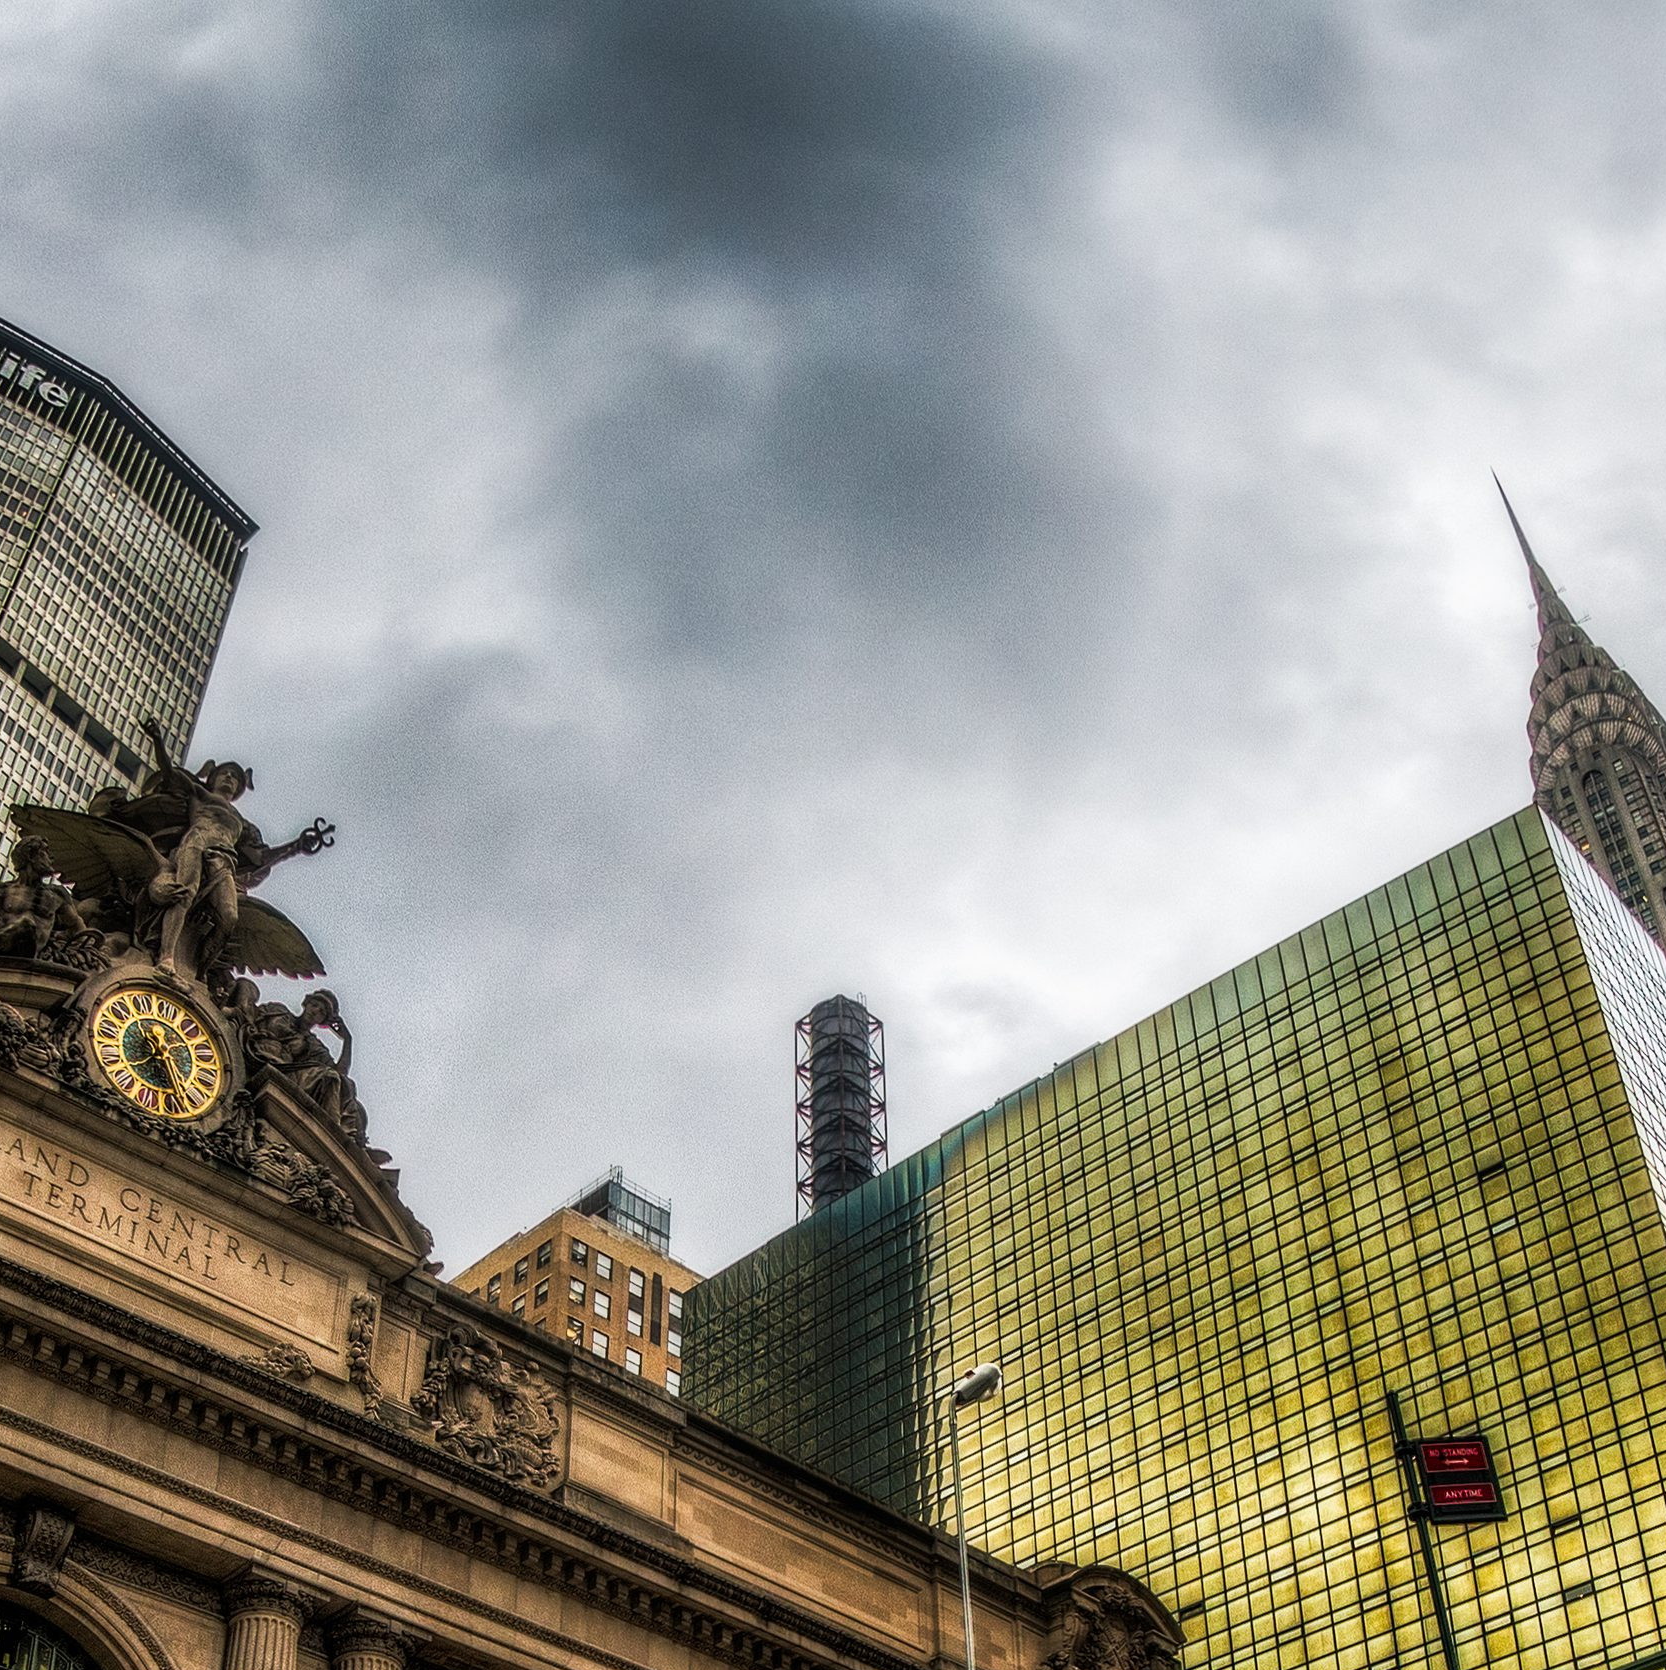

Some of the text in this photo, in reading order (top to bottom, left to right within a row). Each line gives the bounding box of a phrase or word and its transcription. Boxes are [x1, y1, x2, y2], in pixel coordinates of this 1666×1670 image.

[23, 1170, 218, 1281] TERMINAL
[120, 1187, 295, 1287] CENTRAL
[1429, 1447, 1479, 1457] NO STANDING
[1445, 1488, 1483, 1499] ANYTIME
